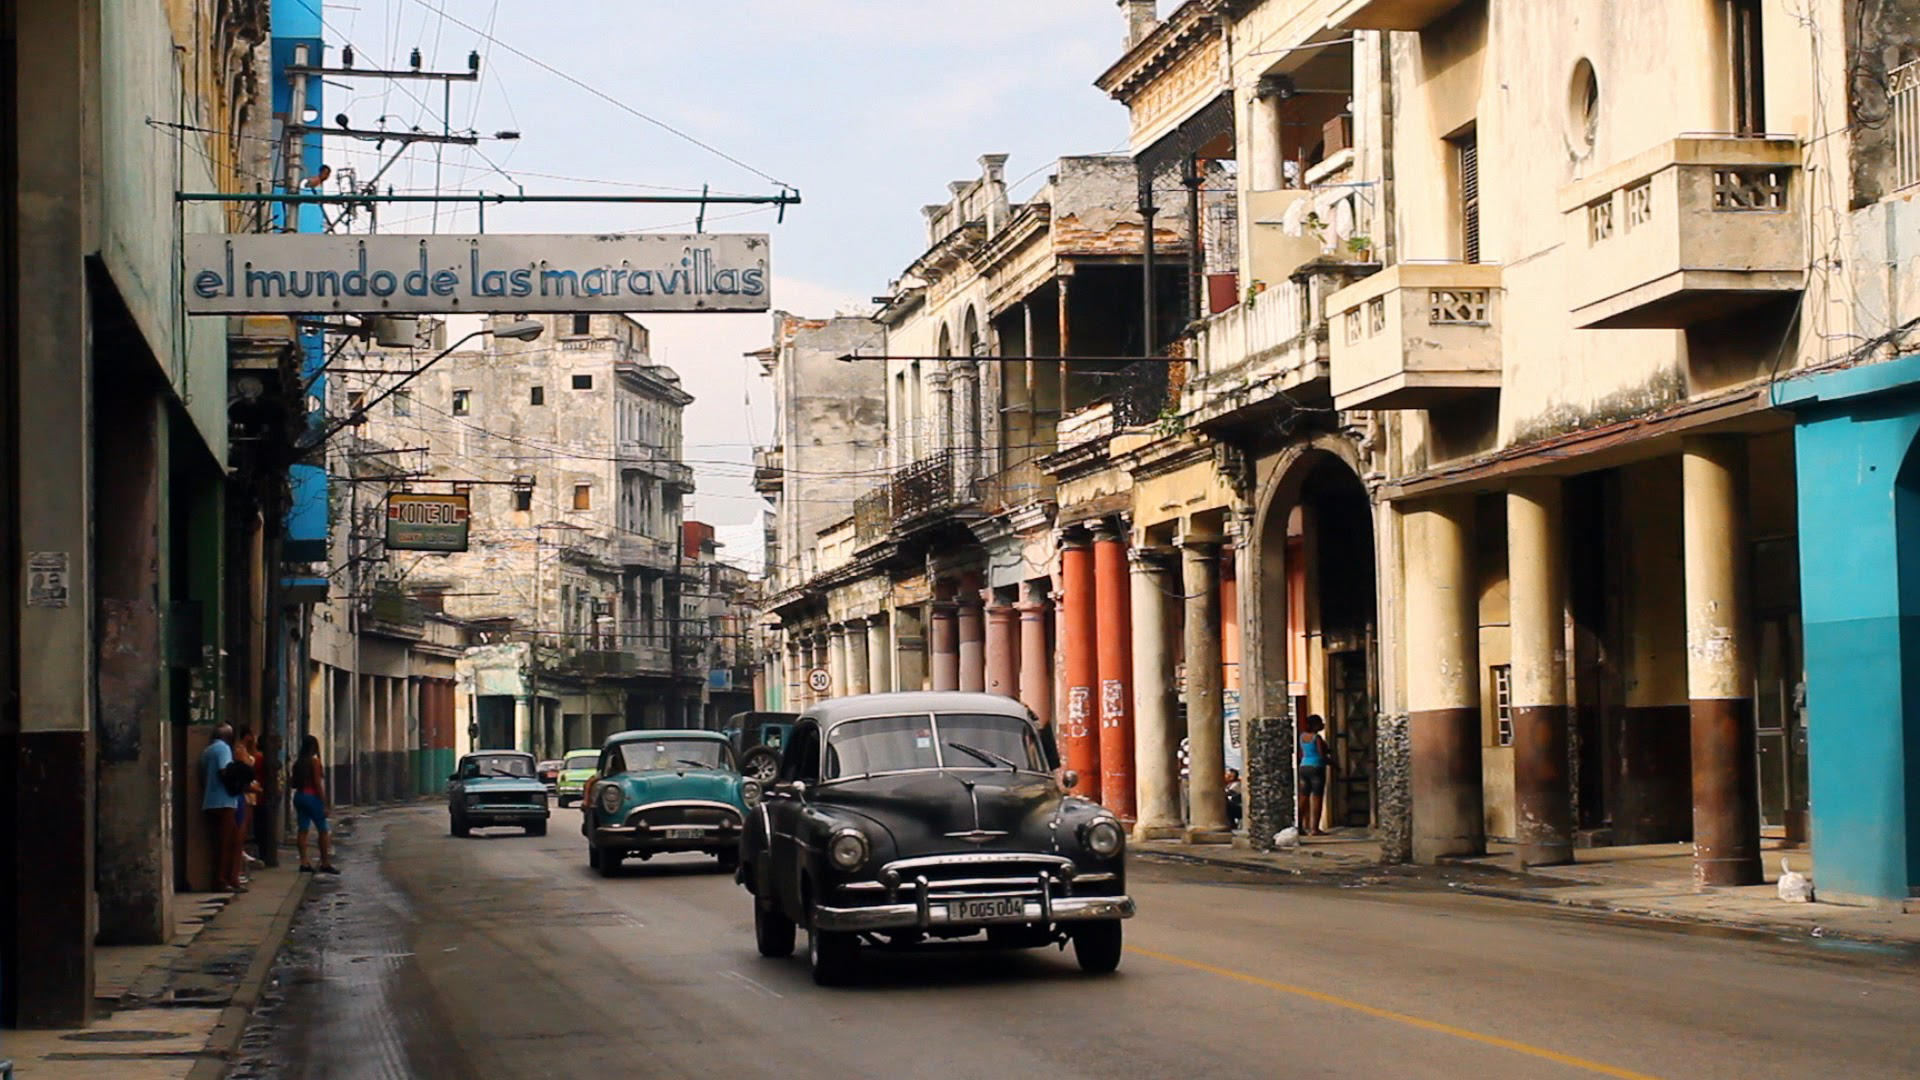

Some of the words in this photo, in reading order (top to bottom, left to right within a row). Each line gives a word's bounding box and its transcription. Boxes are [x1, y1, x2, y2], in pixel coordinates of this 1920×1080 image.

[193, 248, 234, 298] el
[245, 248, 398, 298] mundo
[403, 248, 460, 297] de
[470, 248, 533, 297] las
[540, 247, 765, 297] maravillas
[812, 673, 827, 687] 30
